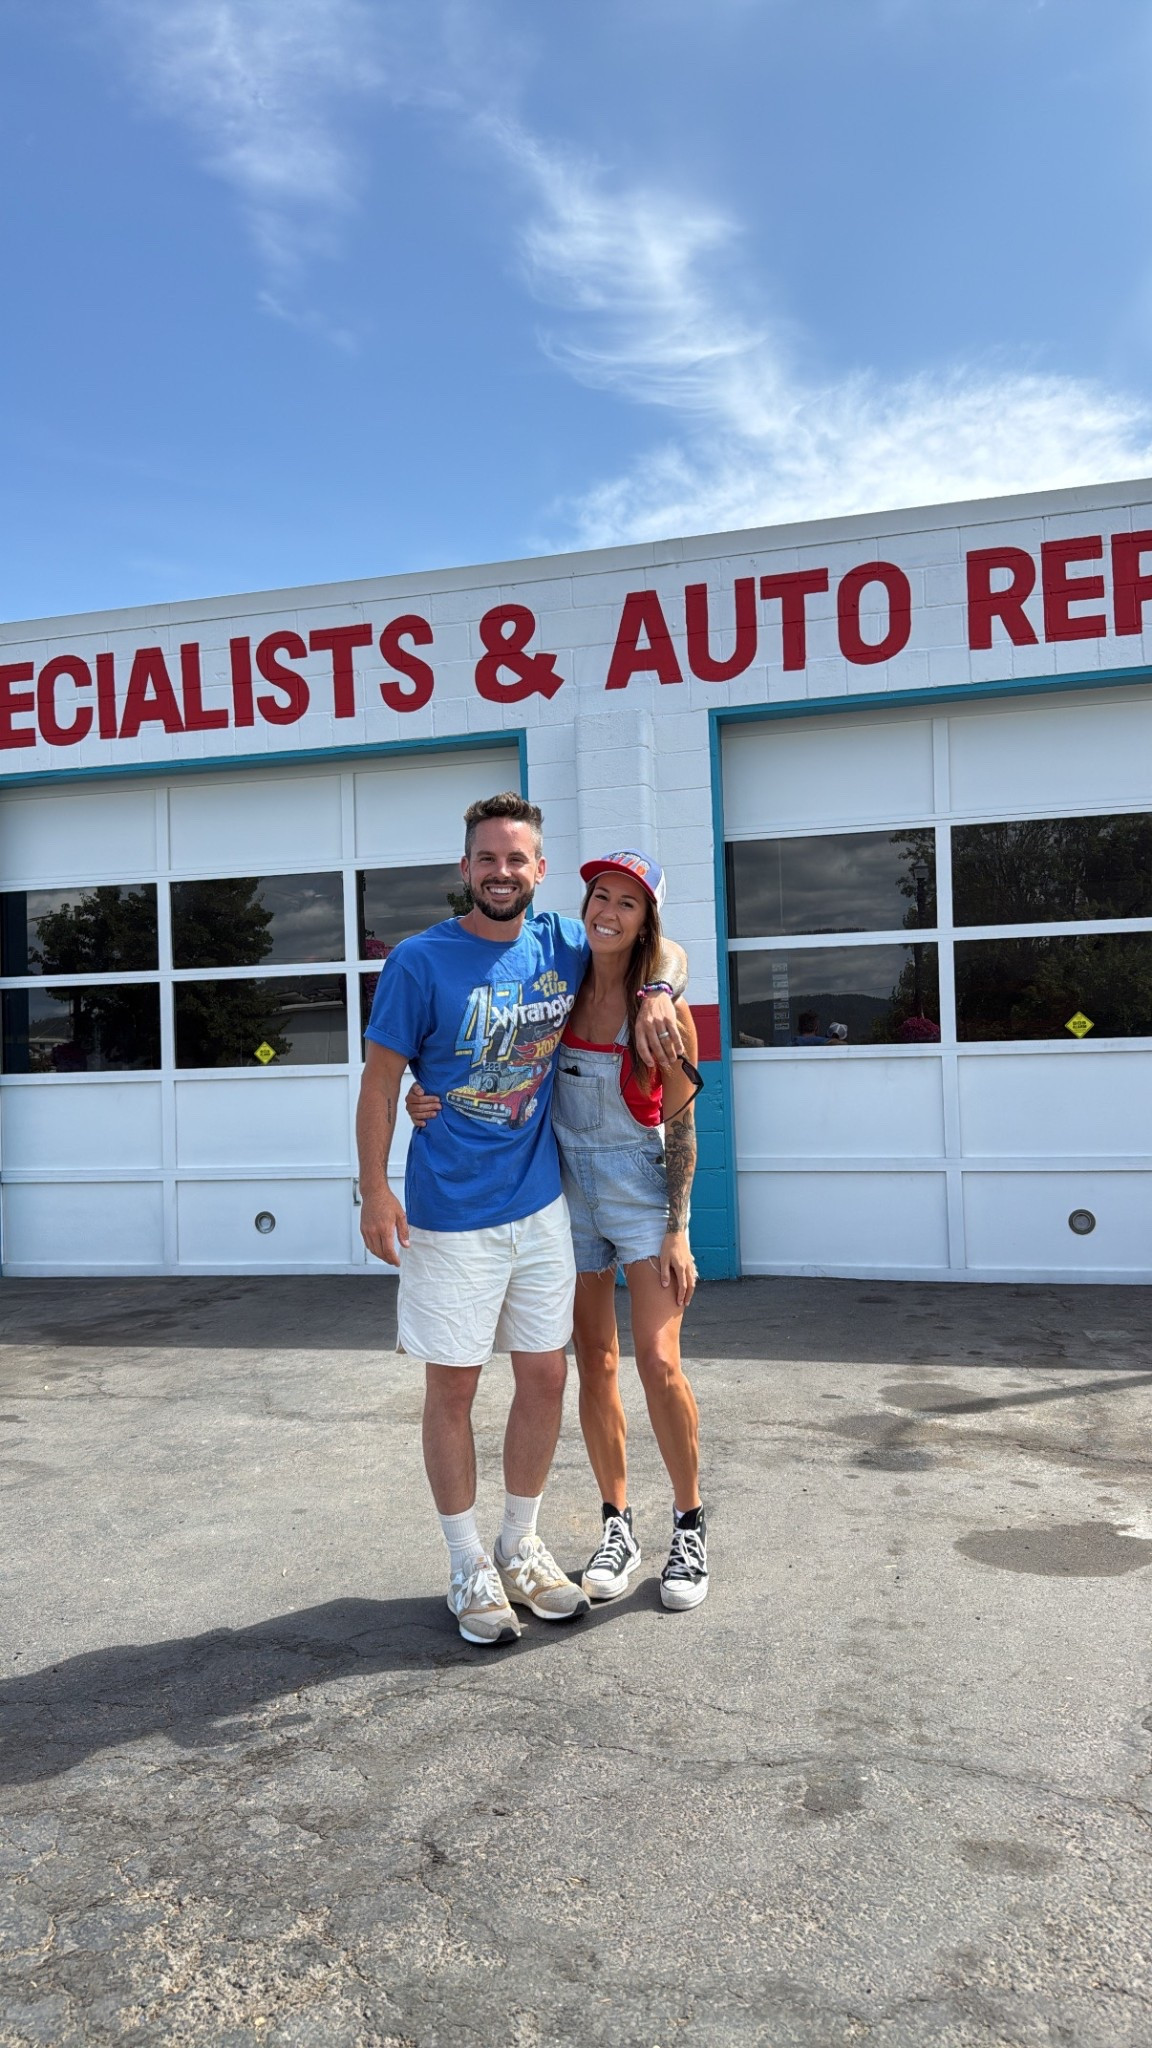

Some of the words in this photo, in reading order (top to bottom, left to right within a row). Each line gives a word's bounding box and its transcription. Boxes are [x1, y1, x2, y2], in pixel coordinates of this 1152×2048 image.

[0, 614, 434, 749] ECIALISTS
[475, 604, 564, 703] &
[605, 562, 911, 690] AUTO
